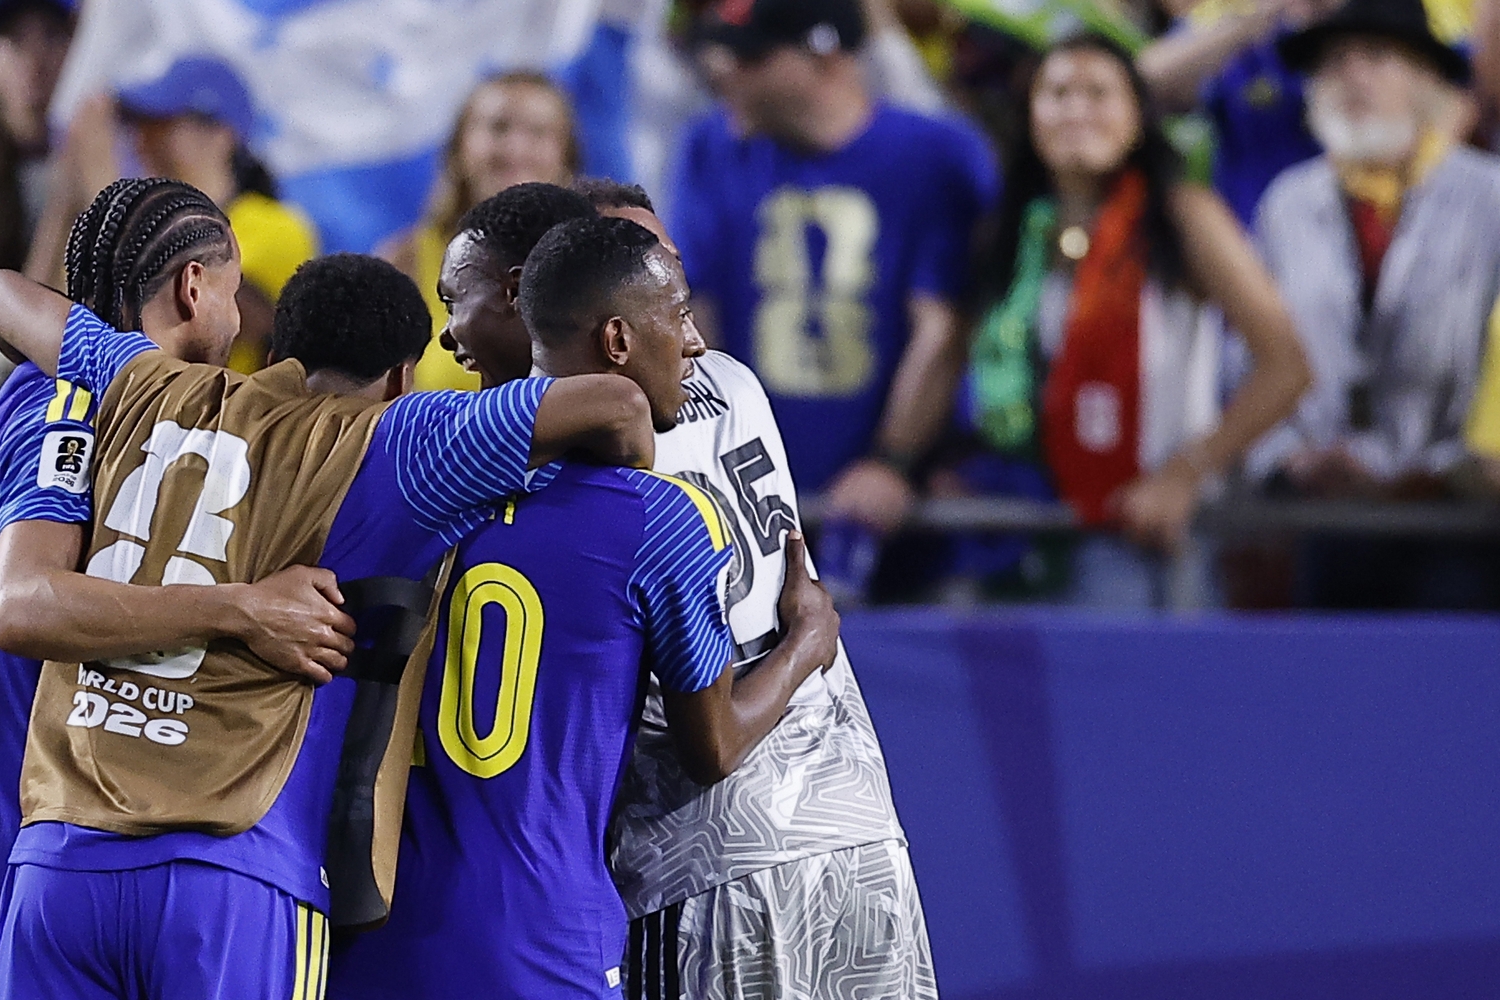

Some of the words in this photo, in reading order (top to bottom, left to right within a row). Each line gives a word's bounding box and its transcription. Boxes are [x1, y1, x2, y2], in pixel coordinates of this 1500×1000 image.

[77, 662, 140, 701] RLD
[142, 687, 194, 714] CUP
[411, 562, 545, 779] 0
[66, 690, 189, 746] 2026
